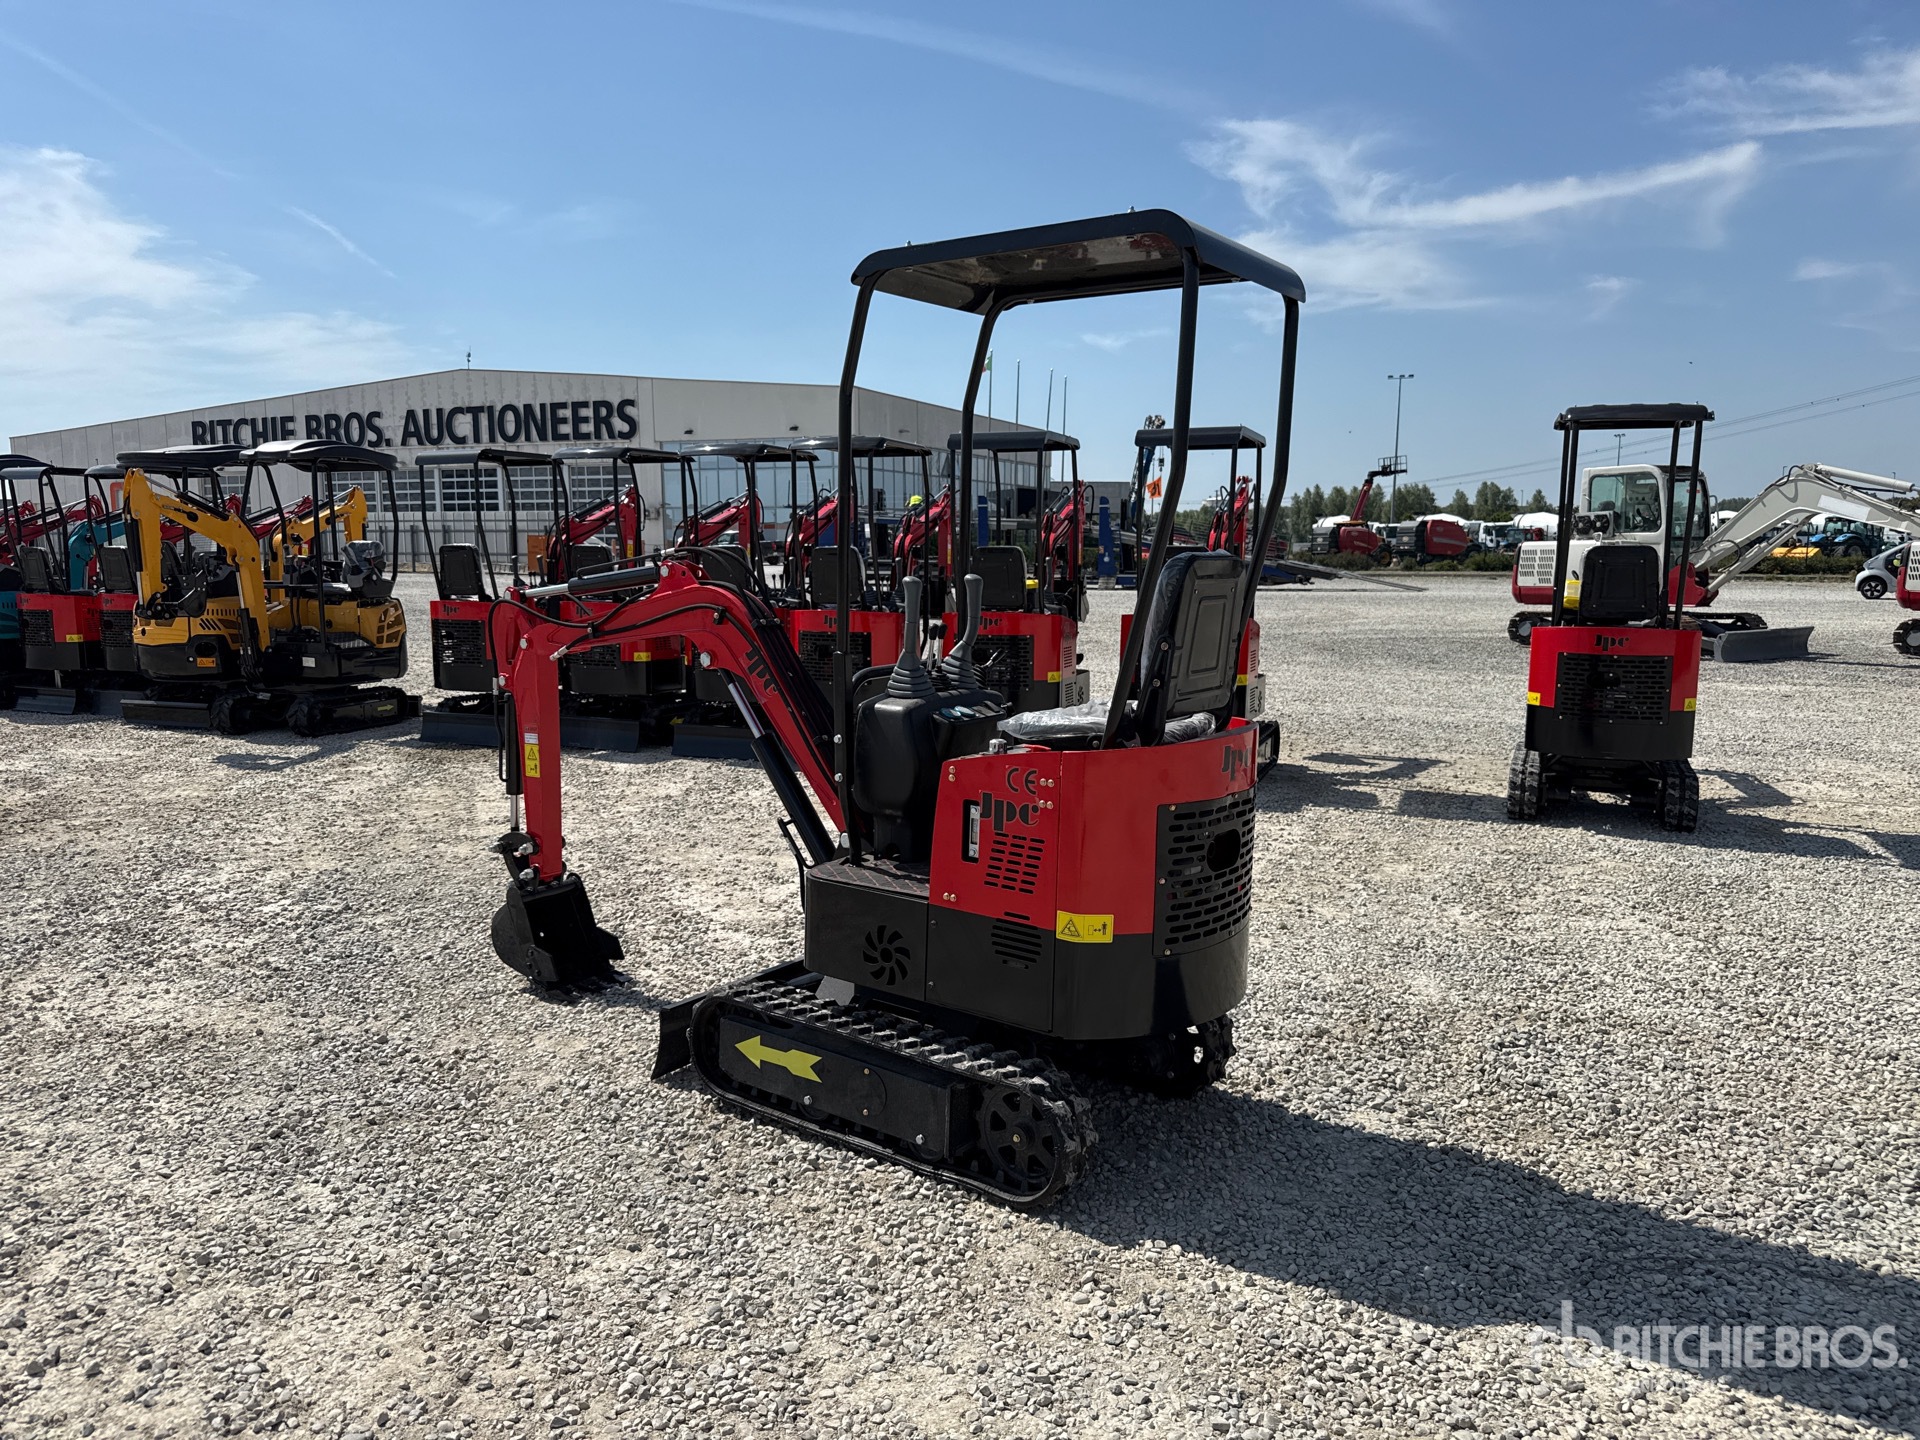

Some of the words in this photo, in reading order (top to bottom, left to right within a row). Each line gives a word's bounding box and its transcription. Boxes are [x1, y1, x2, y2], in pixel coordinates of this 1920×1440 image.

[191, 415, 296, 448] RITCHIE
[304, 410, 392, 448] BROS.
[401, 398, 638, 447] AUCTIONEERS
[1006, 767, 1038, 795] CE
